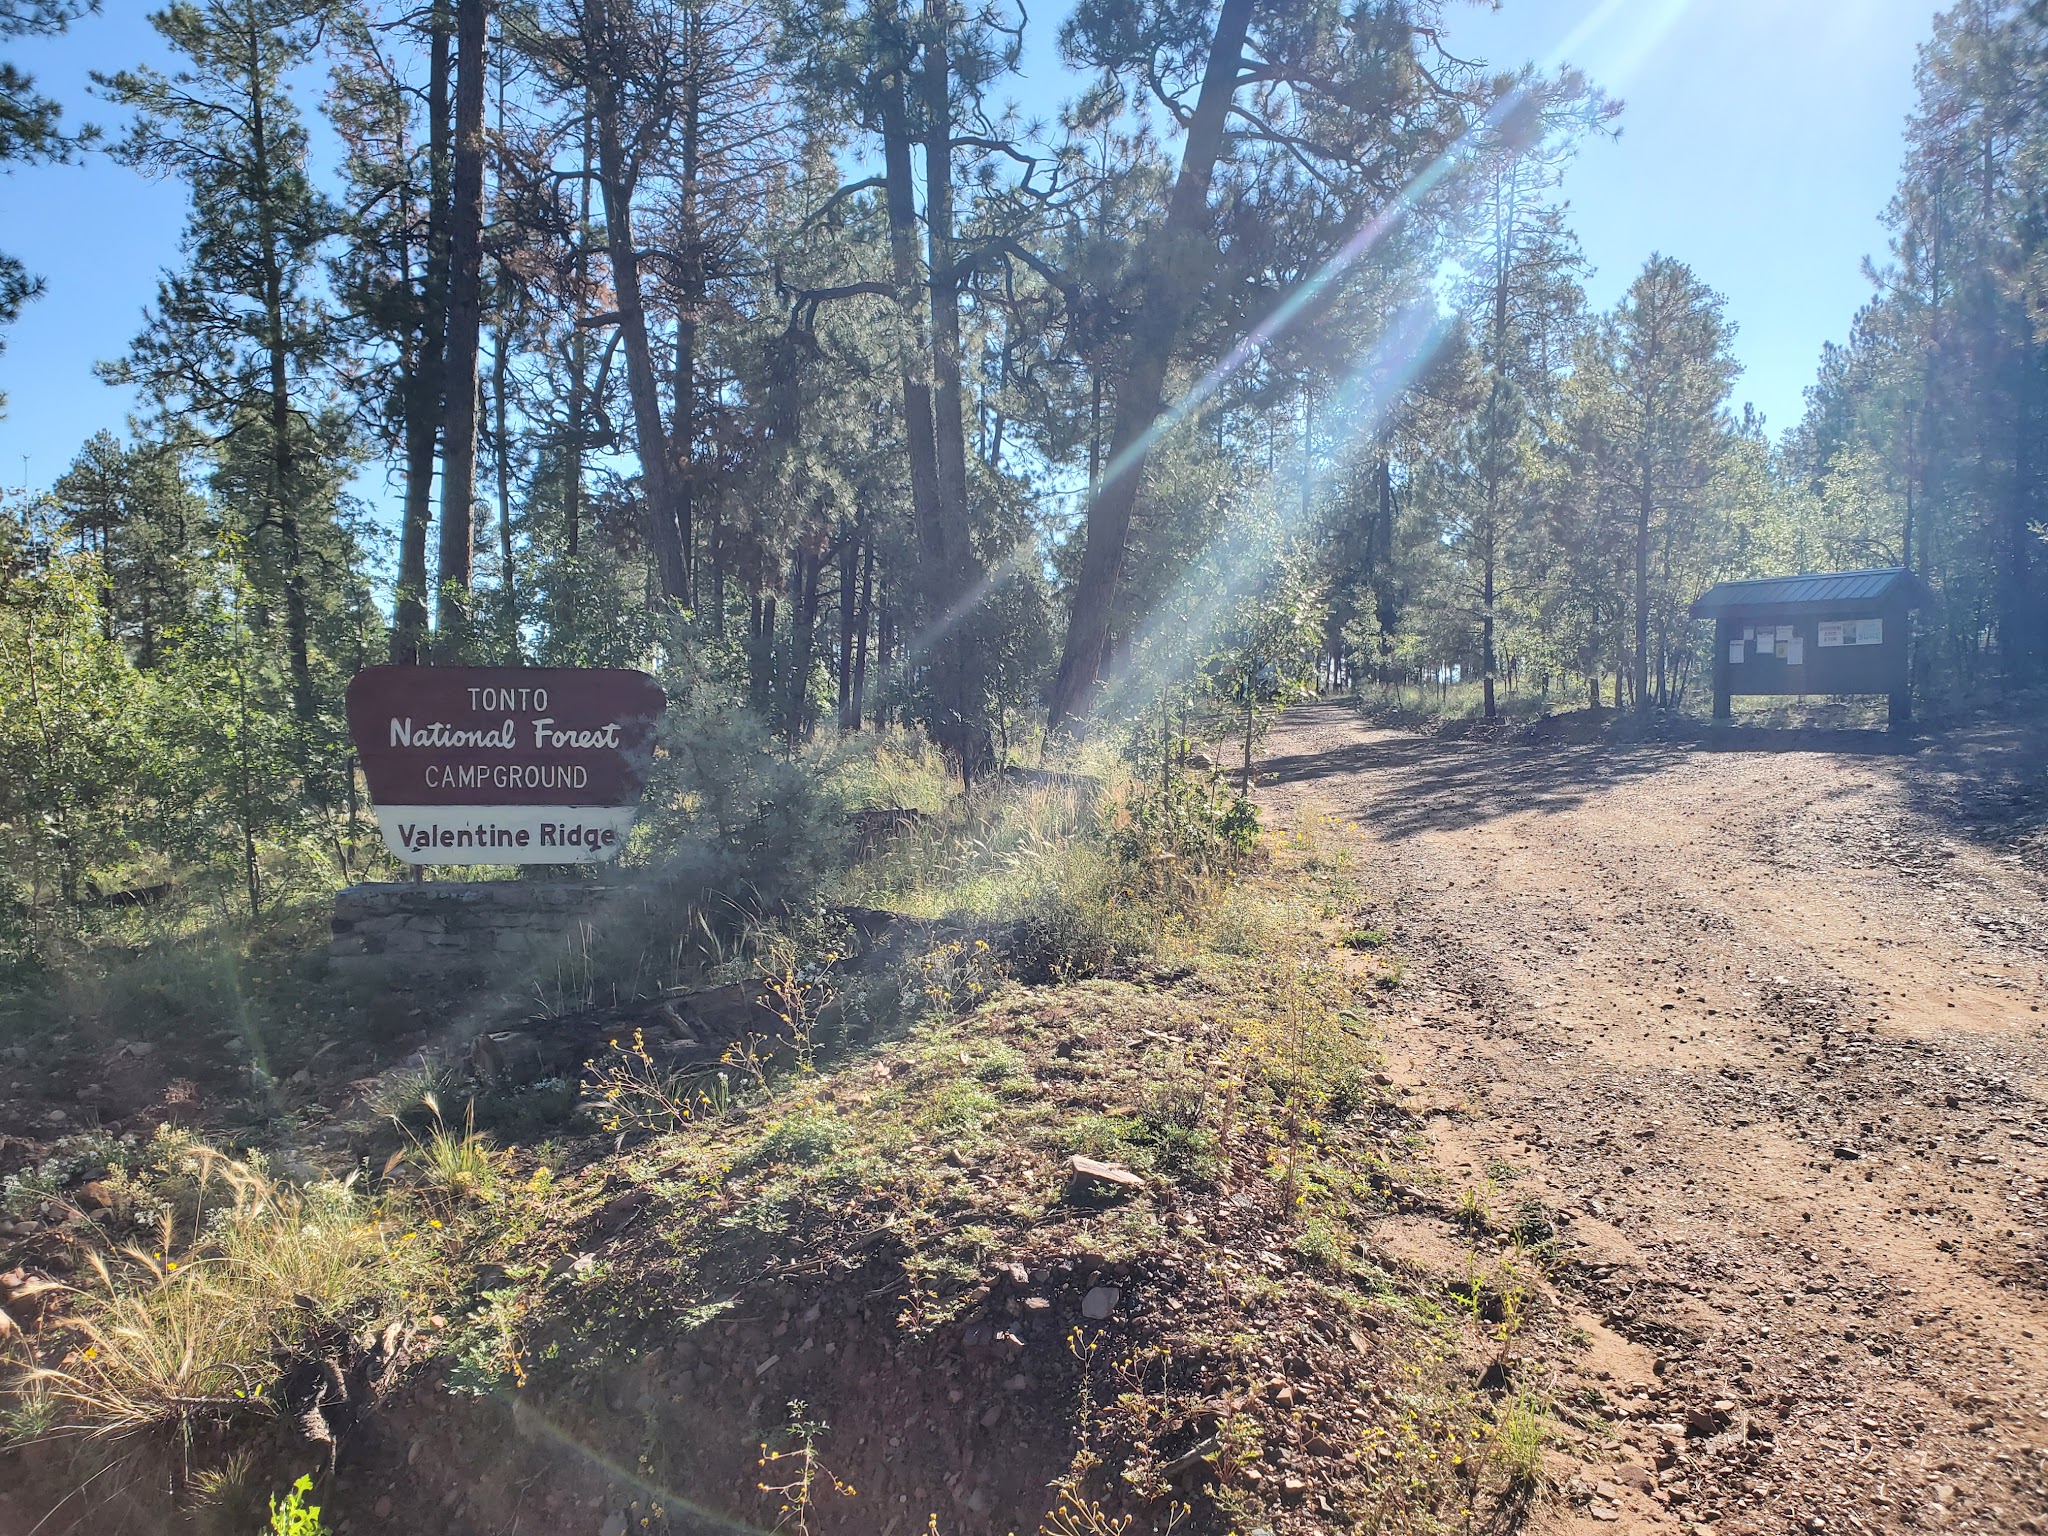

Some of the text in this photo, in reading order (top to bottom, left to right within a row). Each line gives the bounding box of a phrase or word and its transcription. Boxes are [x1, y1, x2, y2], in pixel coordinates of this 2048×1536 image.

[467, 688, 548, 711] TONTO
[390, 717, 621, 749] National Forest
[425, 765, 588, 789] CAMPGROUND
[398, 823, 616, 852] Valentine Ridge
